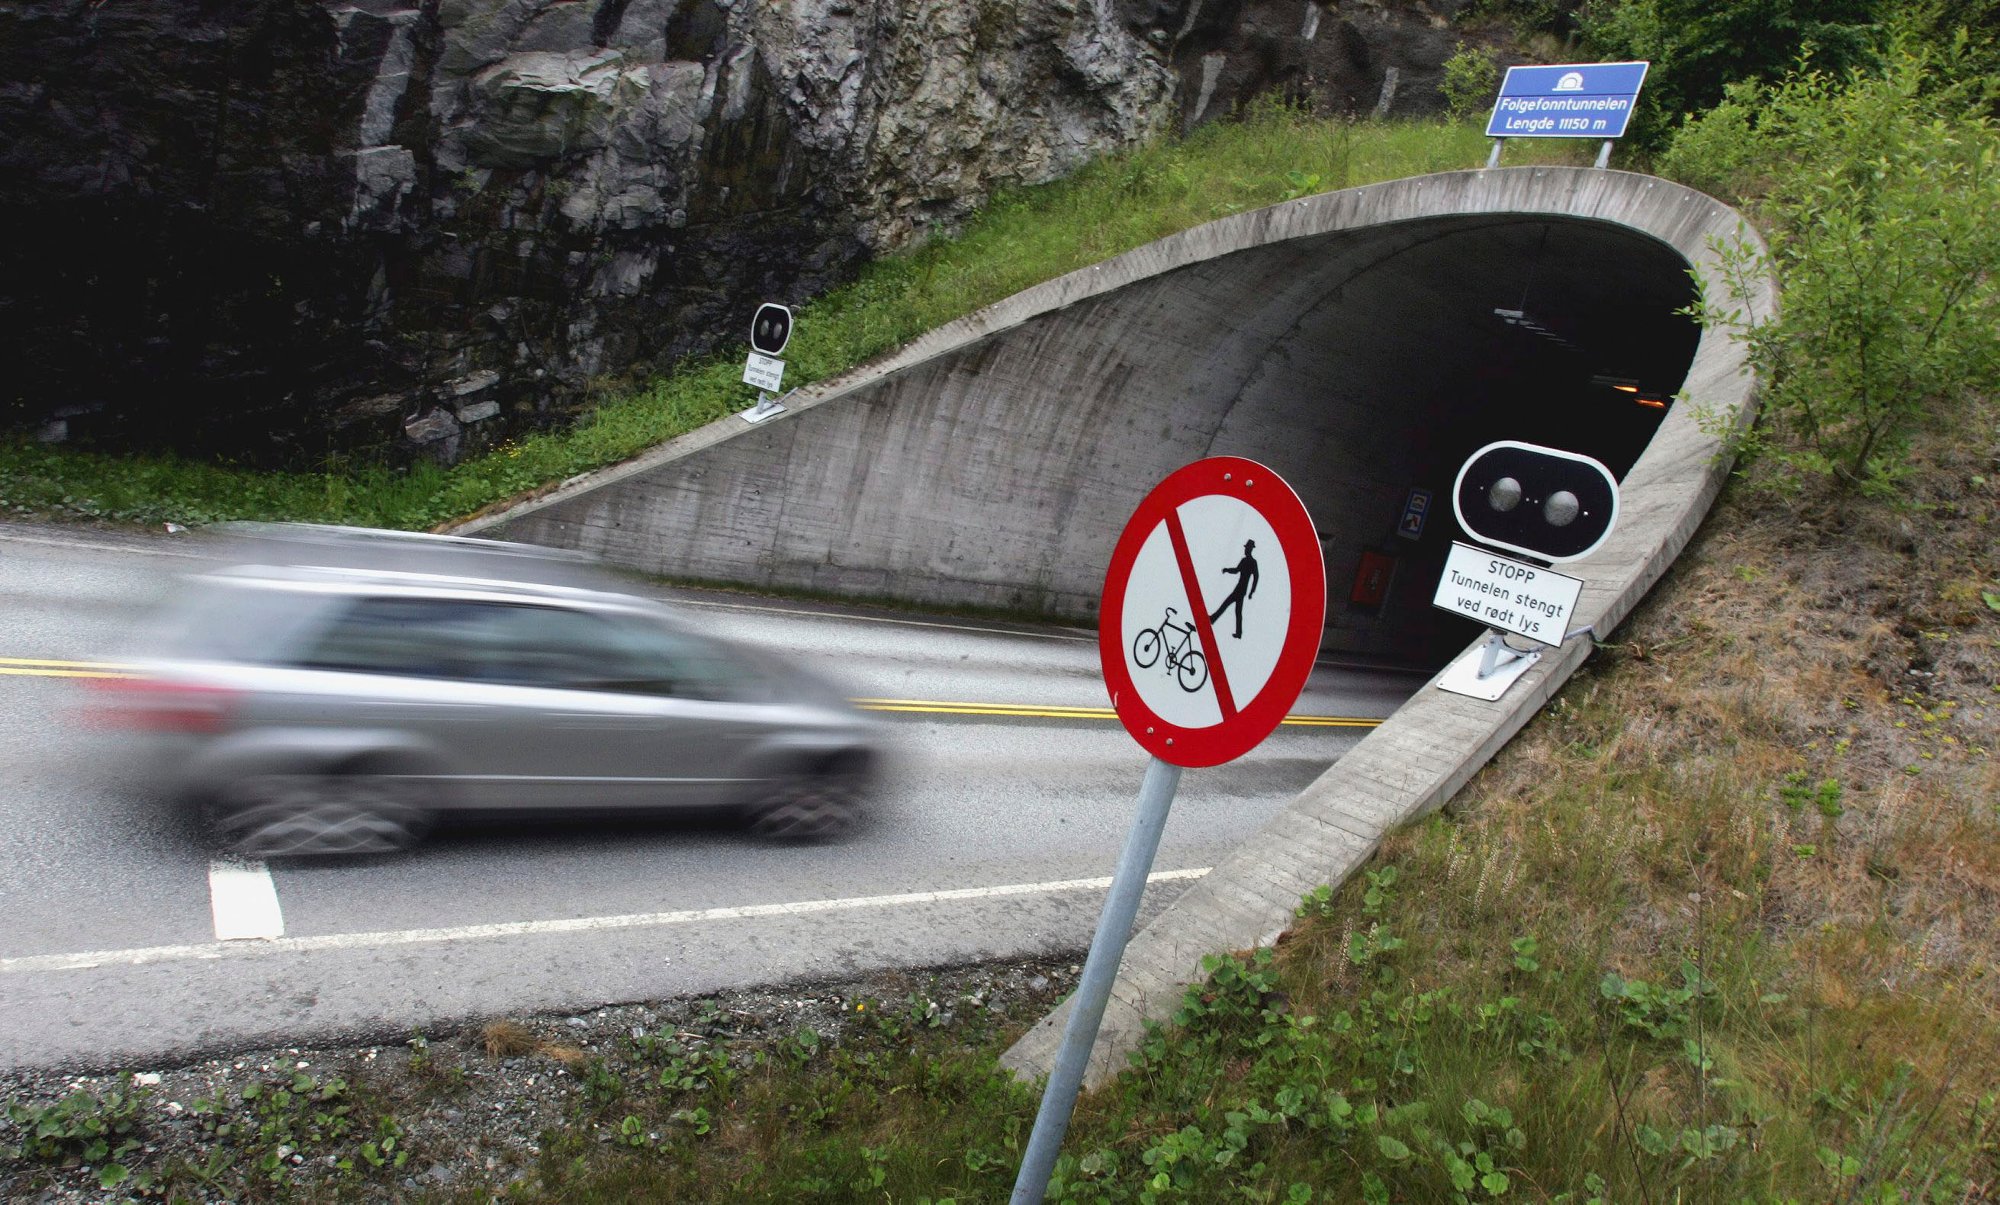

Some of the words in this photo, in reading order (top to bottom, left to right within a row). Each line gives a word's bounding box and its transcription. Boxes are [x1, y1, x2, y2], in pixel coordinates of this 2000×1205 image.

[1500, 97, 1628, 114] Folgefonntunnelen
[1506, 117, 1554, 132] Lengde
[1558, 117, 1589, 130] 11150
[1592, 119, 1606, 130] m
[1488, 560, 1535, 584] STOPP
[1450, 570, 1510, 600] Tunnelen
[1515, 593, 1563, 618] stengt
[1457, 596, 1481, 613] ved
[1485, 605, 1514, 624] rødt
[1519, 614, 1540, 633] lys
